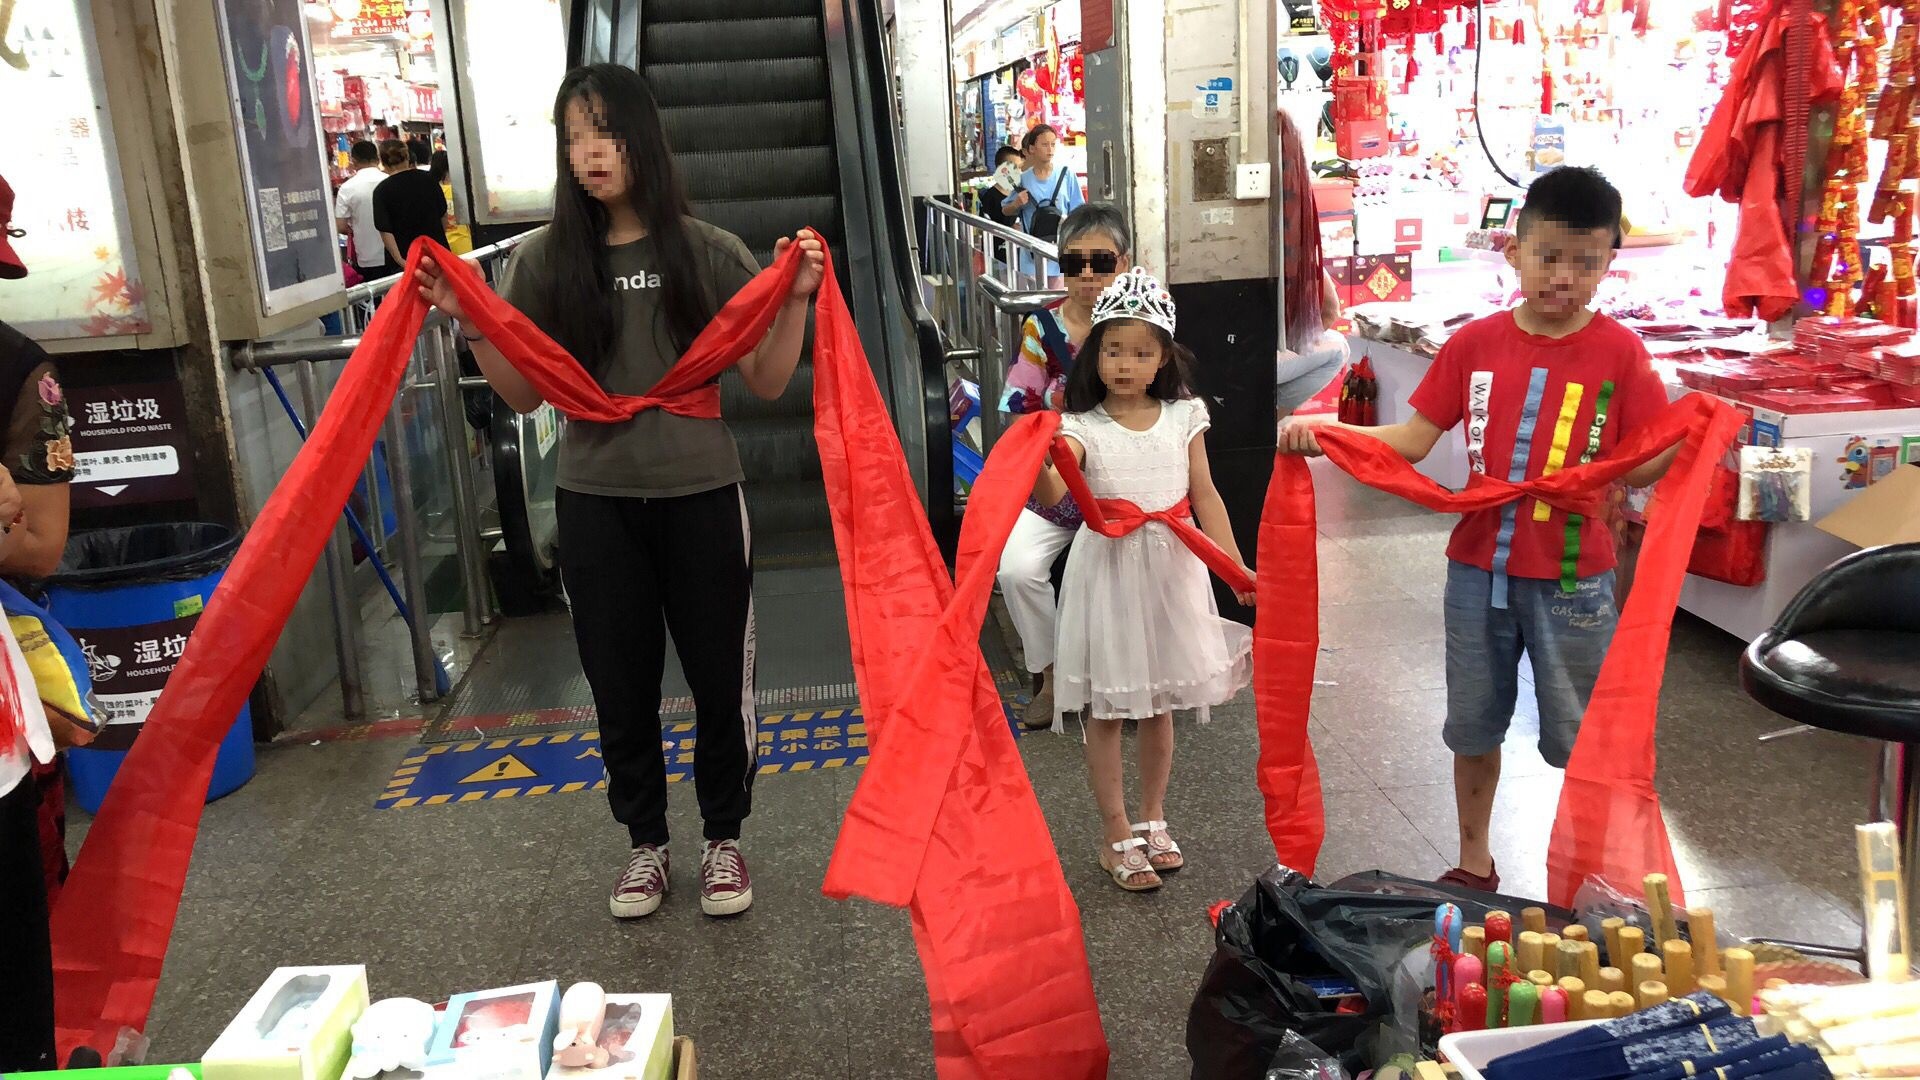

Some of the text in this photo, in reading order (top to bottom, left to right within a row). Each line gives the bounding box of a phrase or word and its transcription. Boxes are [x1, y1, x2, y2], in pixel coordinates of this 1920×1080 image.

[613, 270, 662, 291] nda
[85, 398, 162, 424] 湿垃圾
[80, 423, 173, 437] HOUSEHOLD FOOD WASTE
[1471, 426, 1482, 445] OF
[133, 633, 188, 664] 湿垃
